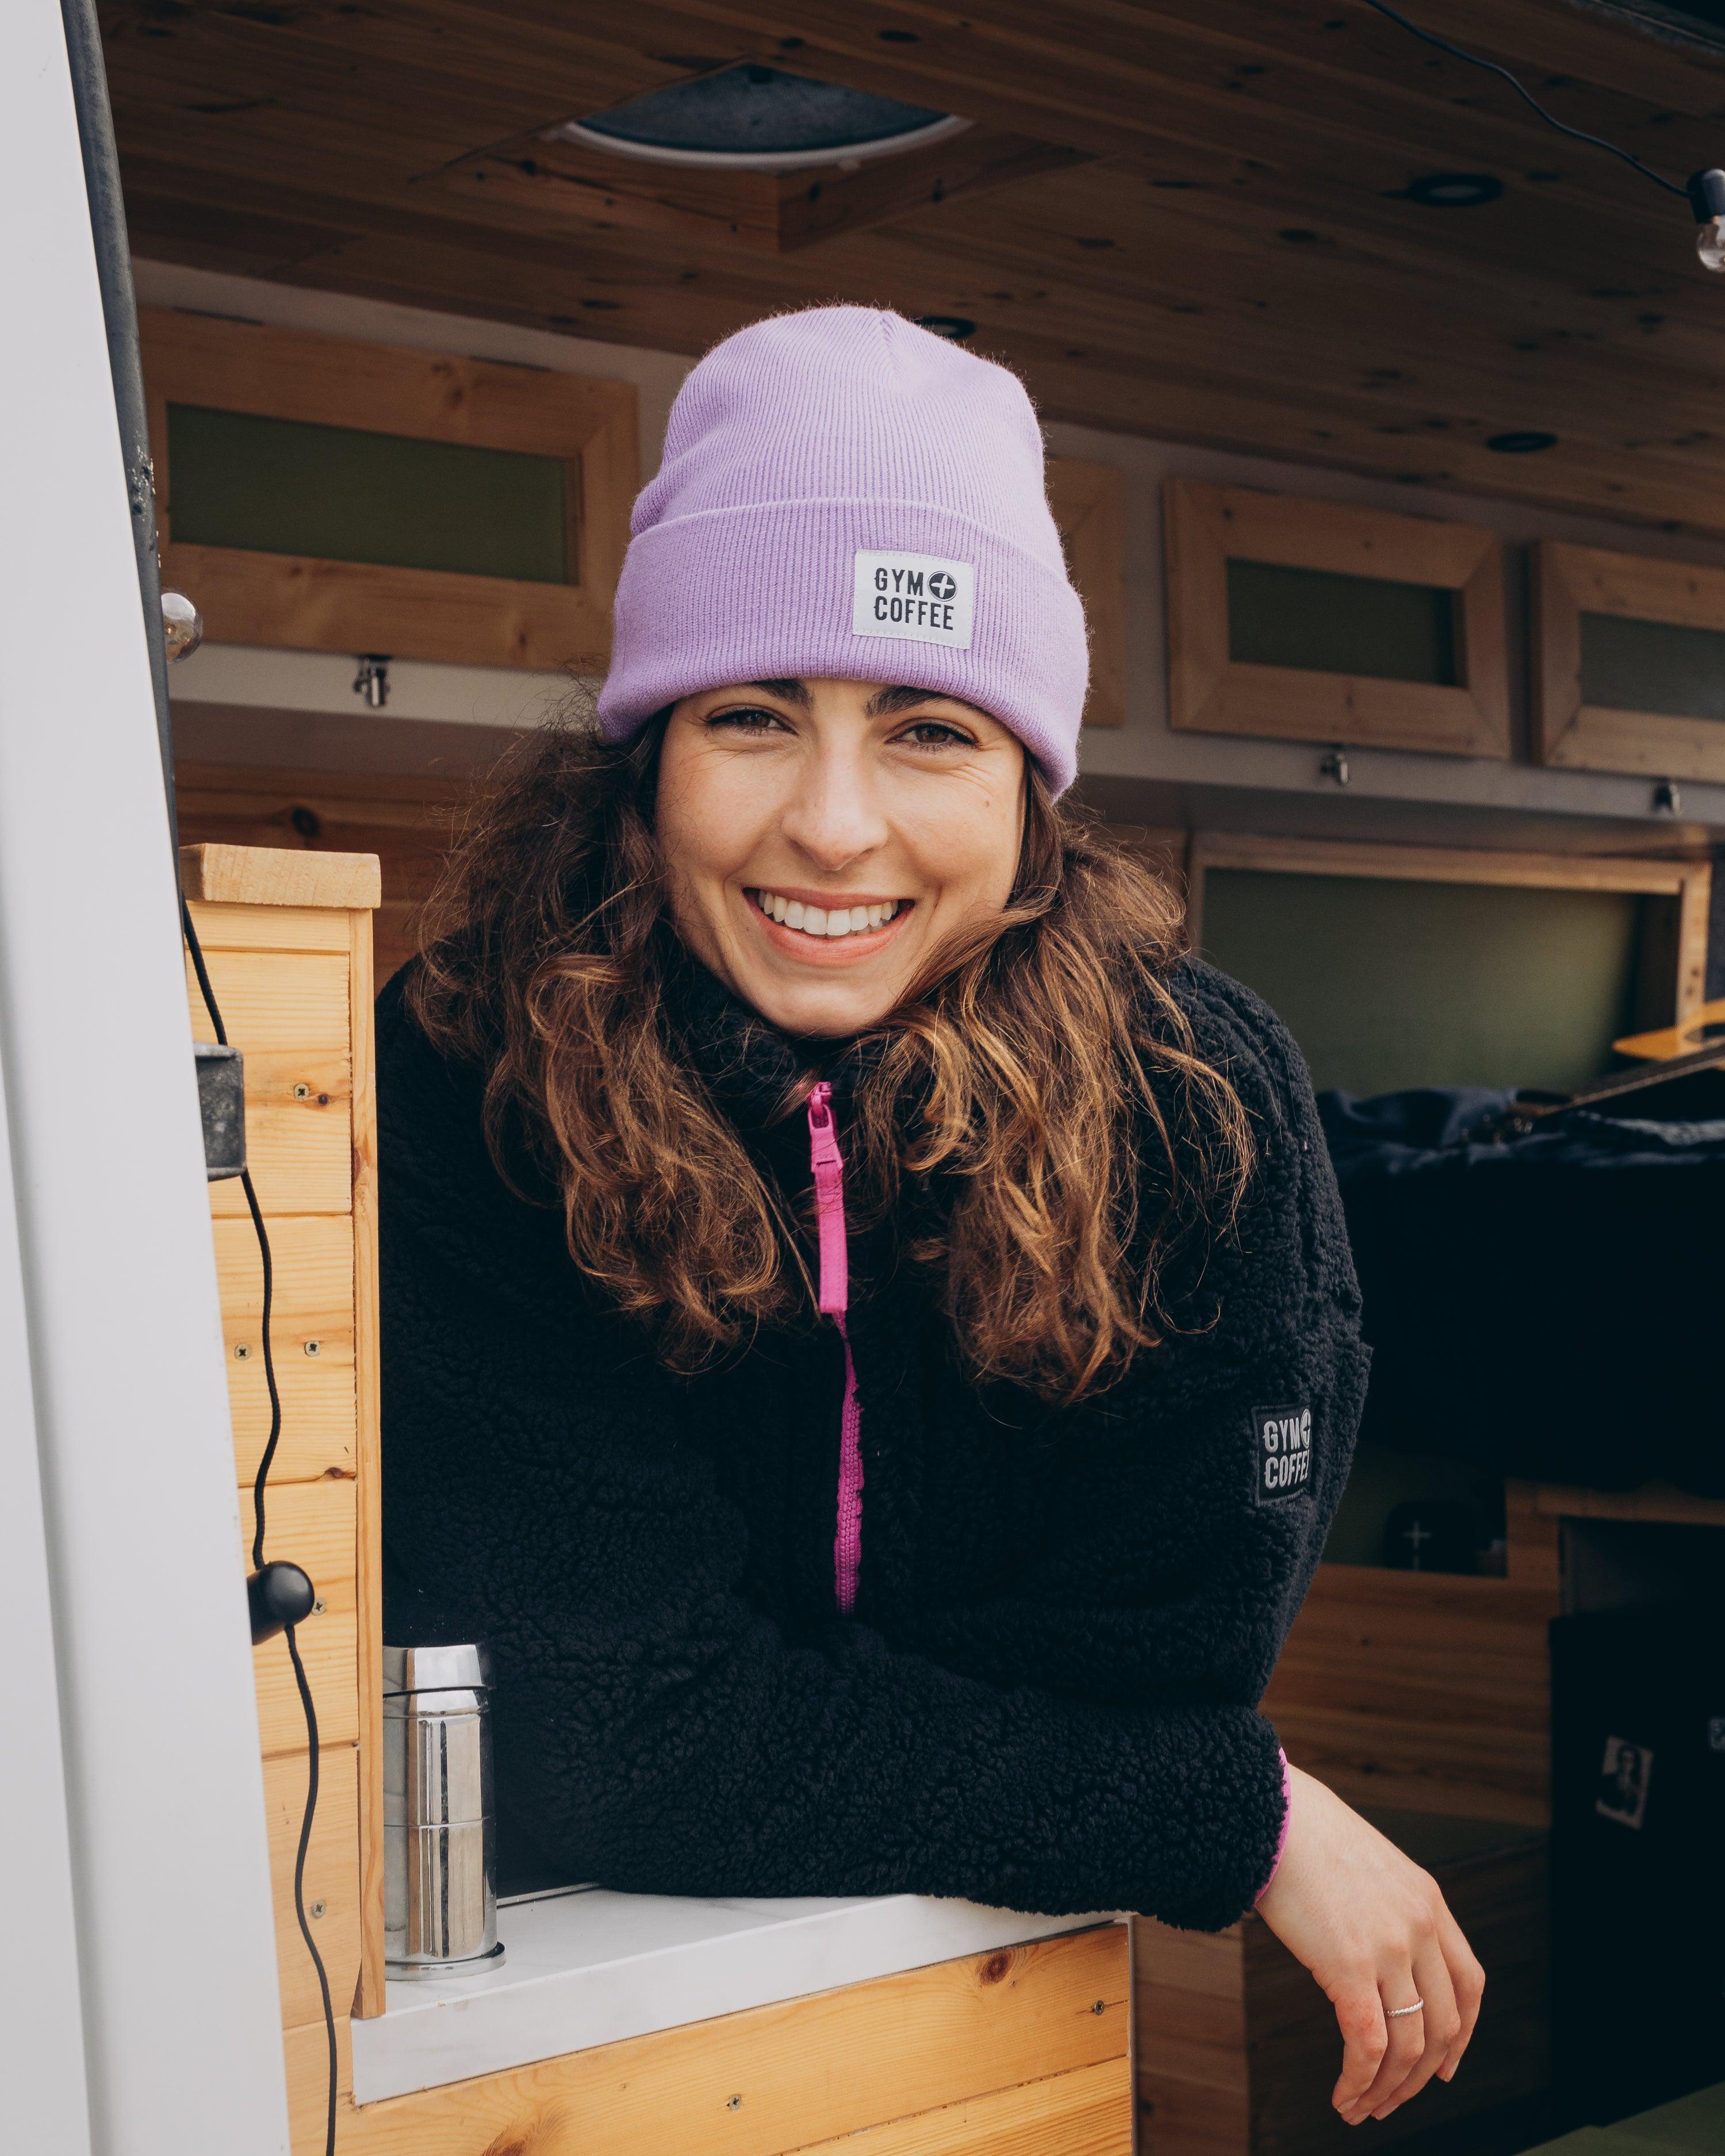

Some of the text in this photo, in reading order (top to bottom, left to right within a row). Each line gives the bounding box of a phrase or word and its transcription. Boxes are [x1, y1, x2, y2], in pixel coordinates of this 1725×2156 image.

[874, 567, 923, 596] GYM
[873, 596, 953, 630] COFFEE
[1263, 1417, 1300, 1452] GYM
